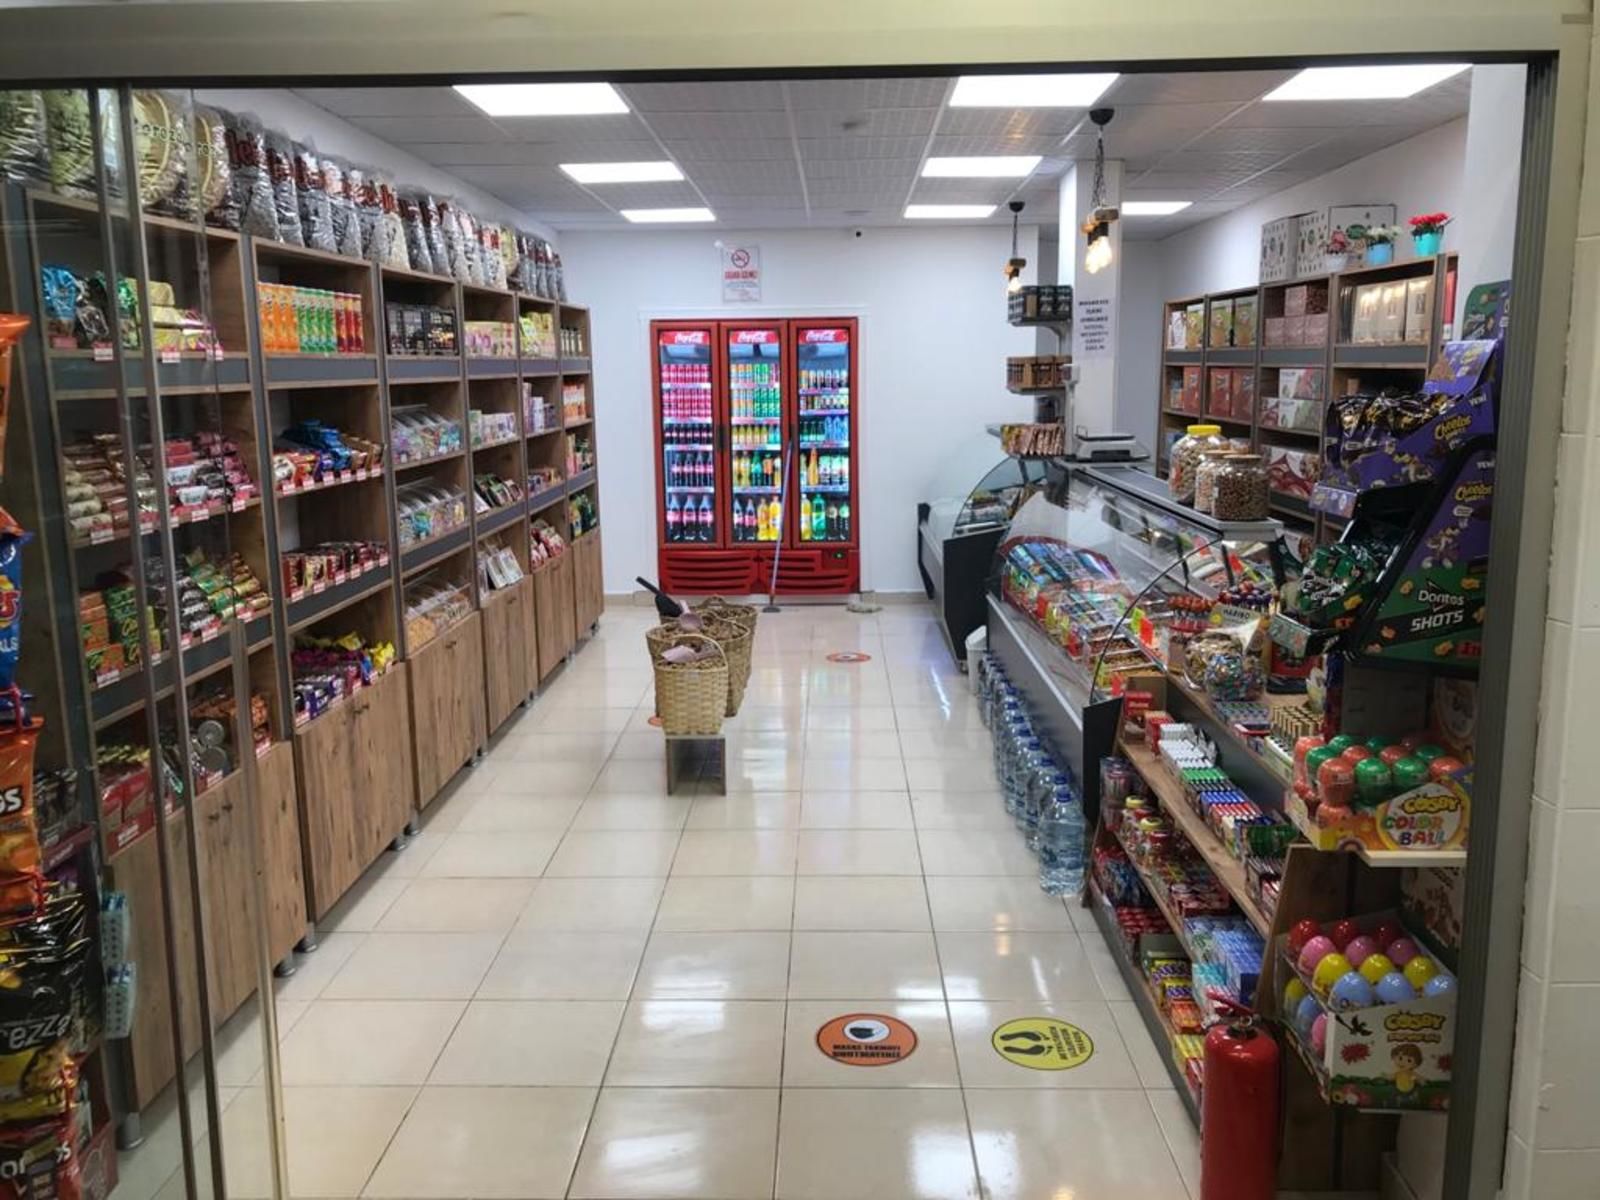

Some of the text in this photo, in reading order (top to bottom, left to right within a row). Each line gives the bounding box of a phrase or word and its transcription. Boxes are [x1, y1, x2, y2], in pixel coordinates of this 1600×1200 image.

[1434, 415, 1473, 440] Cheetos
[1455, 484, 1493, 501] Cheetos
[1418, 589, 1465, 606] Doritos
[1410, 609, 1465, 632] SHOTS
[1384, 815, 1444, 831] COLOR
[1400, 831, 1446, 846] BALL
[0, 1013, 71, 1050] ezza
